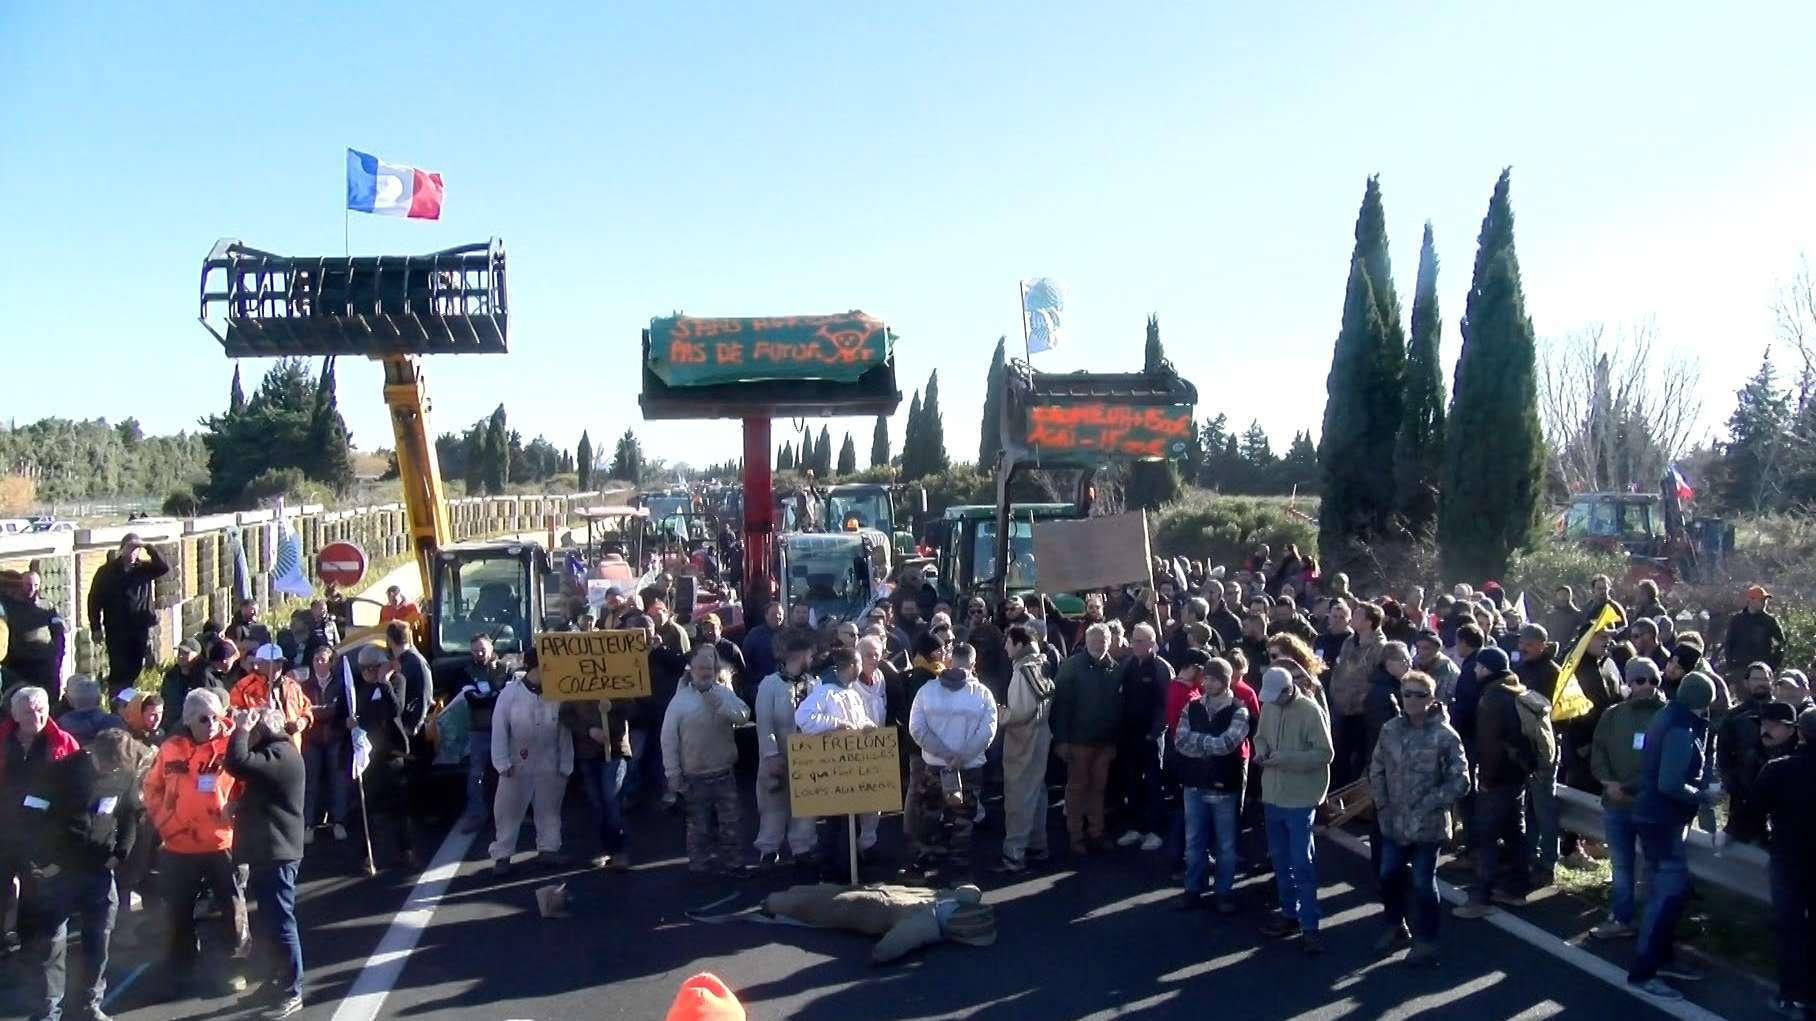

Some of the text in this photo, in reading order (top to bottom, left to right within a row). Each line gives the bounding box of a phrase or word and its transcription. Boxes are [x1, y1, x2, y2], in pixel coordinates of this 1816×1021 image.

[715, 343, 743, 363] DE
[541, 633, 646, 656] APICULTEURS
[579, 657, 606, 674] EN
[639, 670, 643, 691] !
[823, 734, 897, 751] FRELONS
